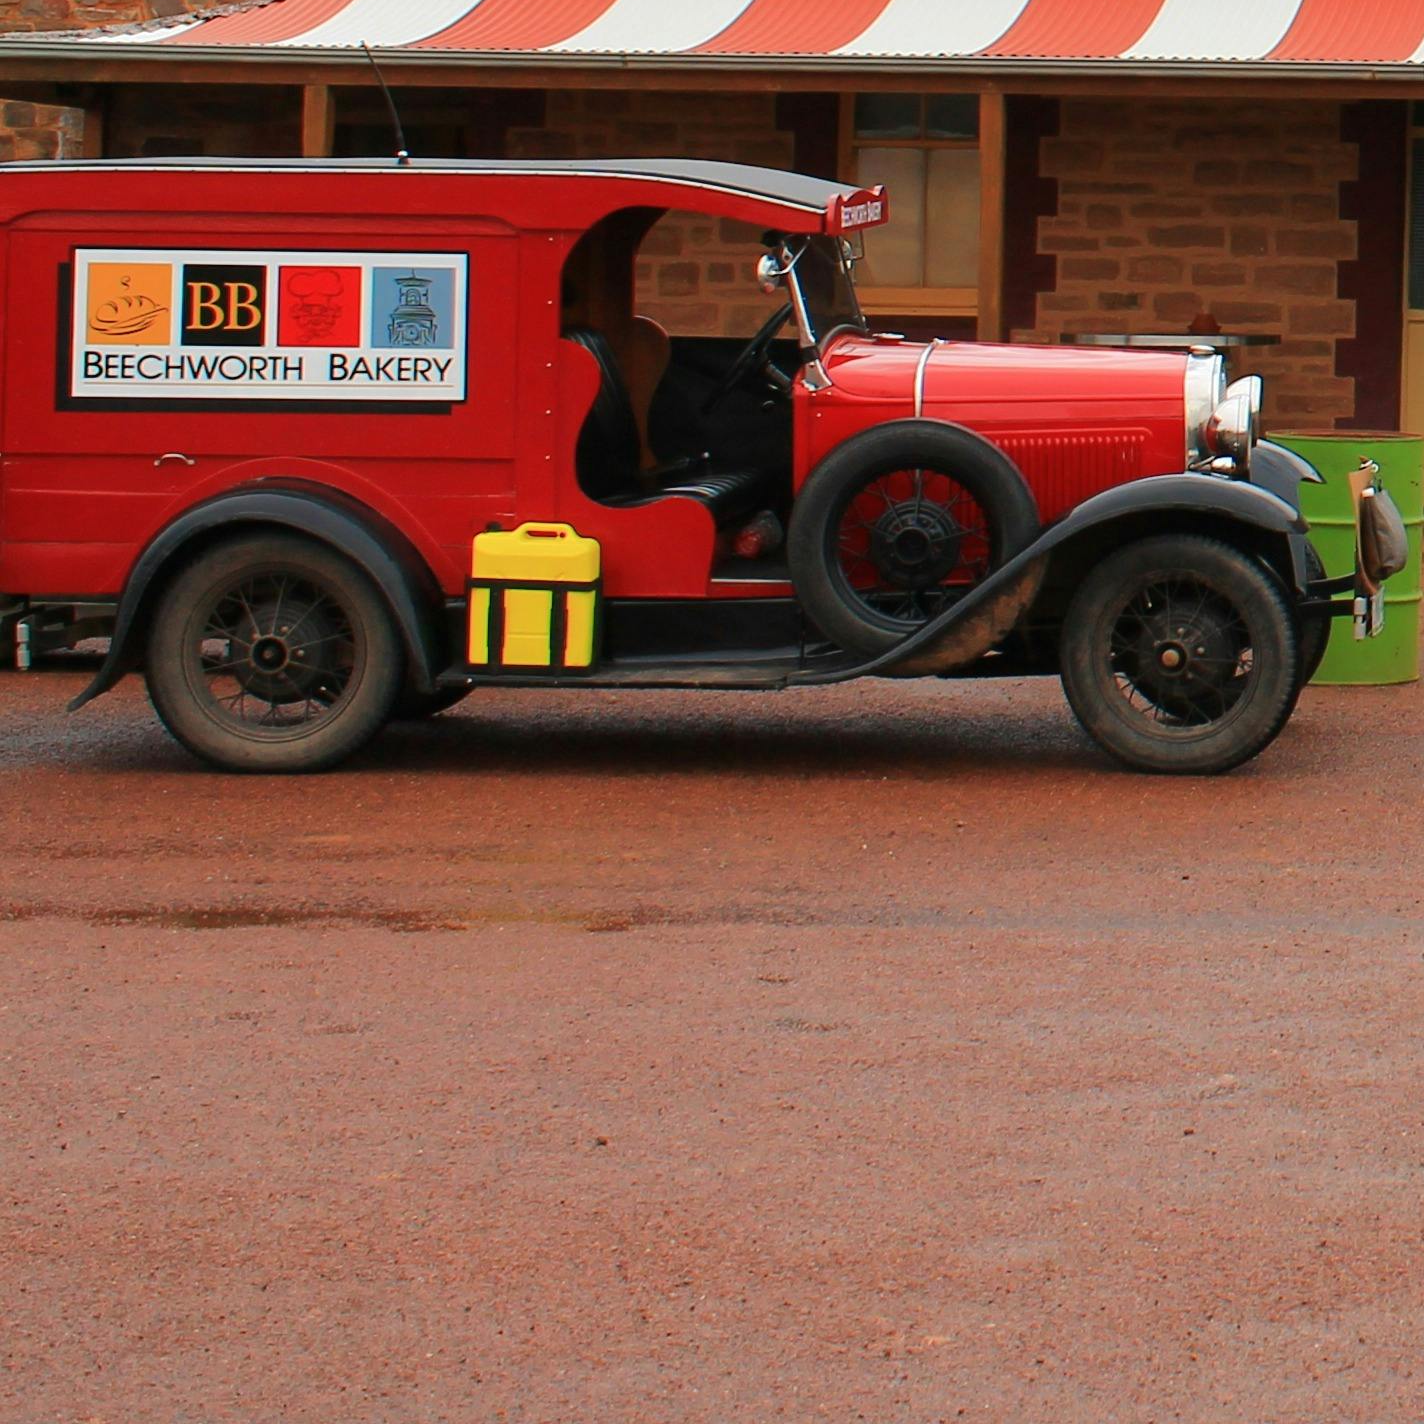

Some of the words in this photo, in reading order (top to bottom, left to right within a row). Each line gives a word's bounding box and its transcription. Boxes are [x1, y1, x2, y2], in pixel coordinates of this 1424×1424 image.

[186, 282, 262, 331] BB
[83, 350, 303, 381] BEECHWORTH
[329, 353, 453, 382] BAKERY
